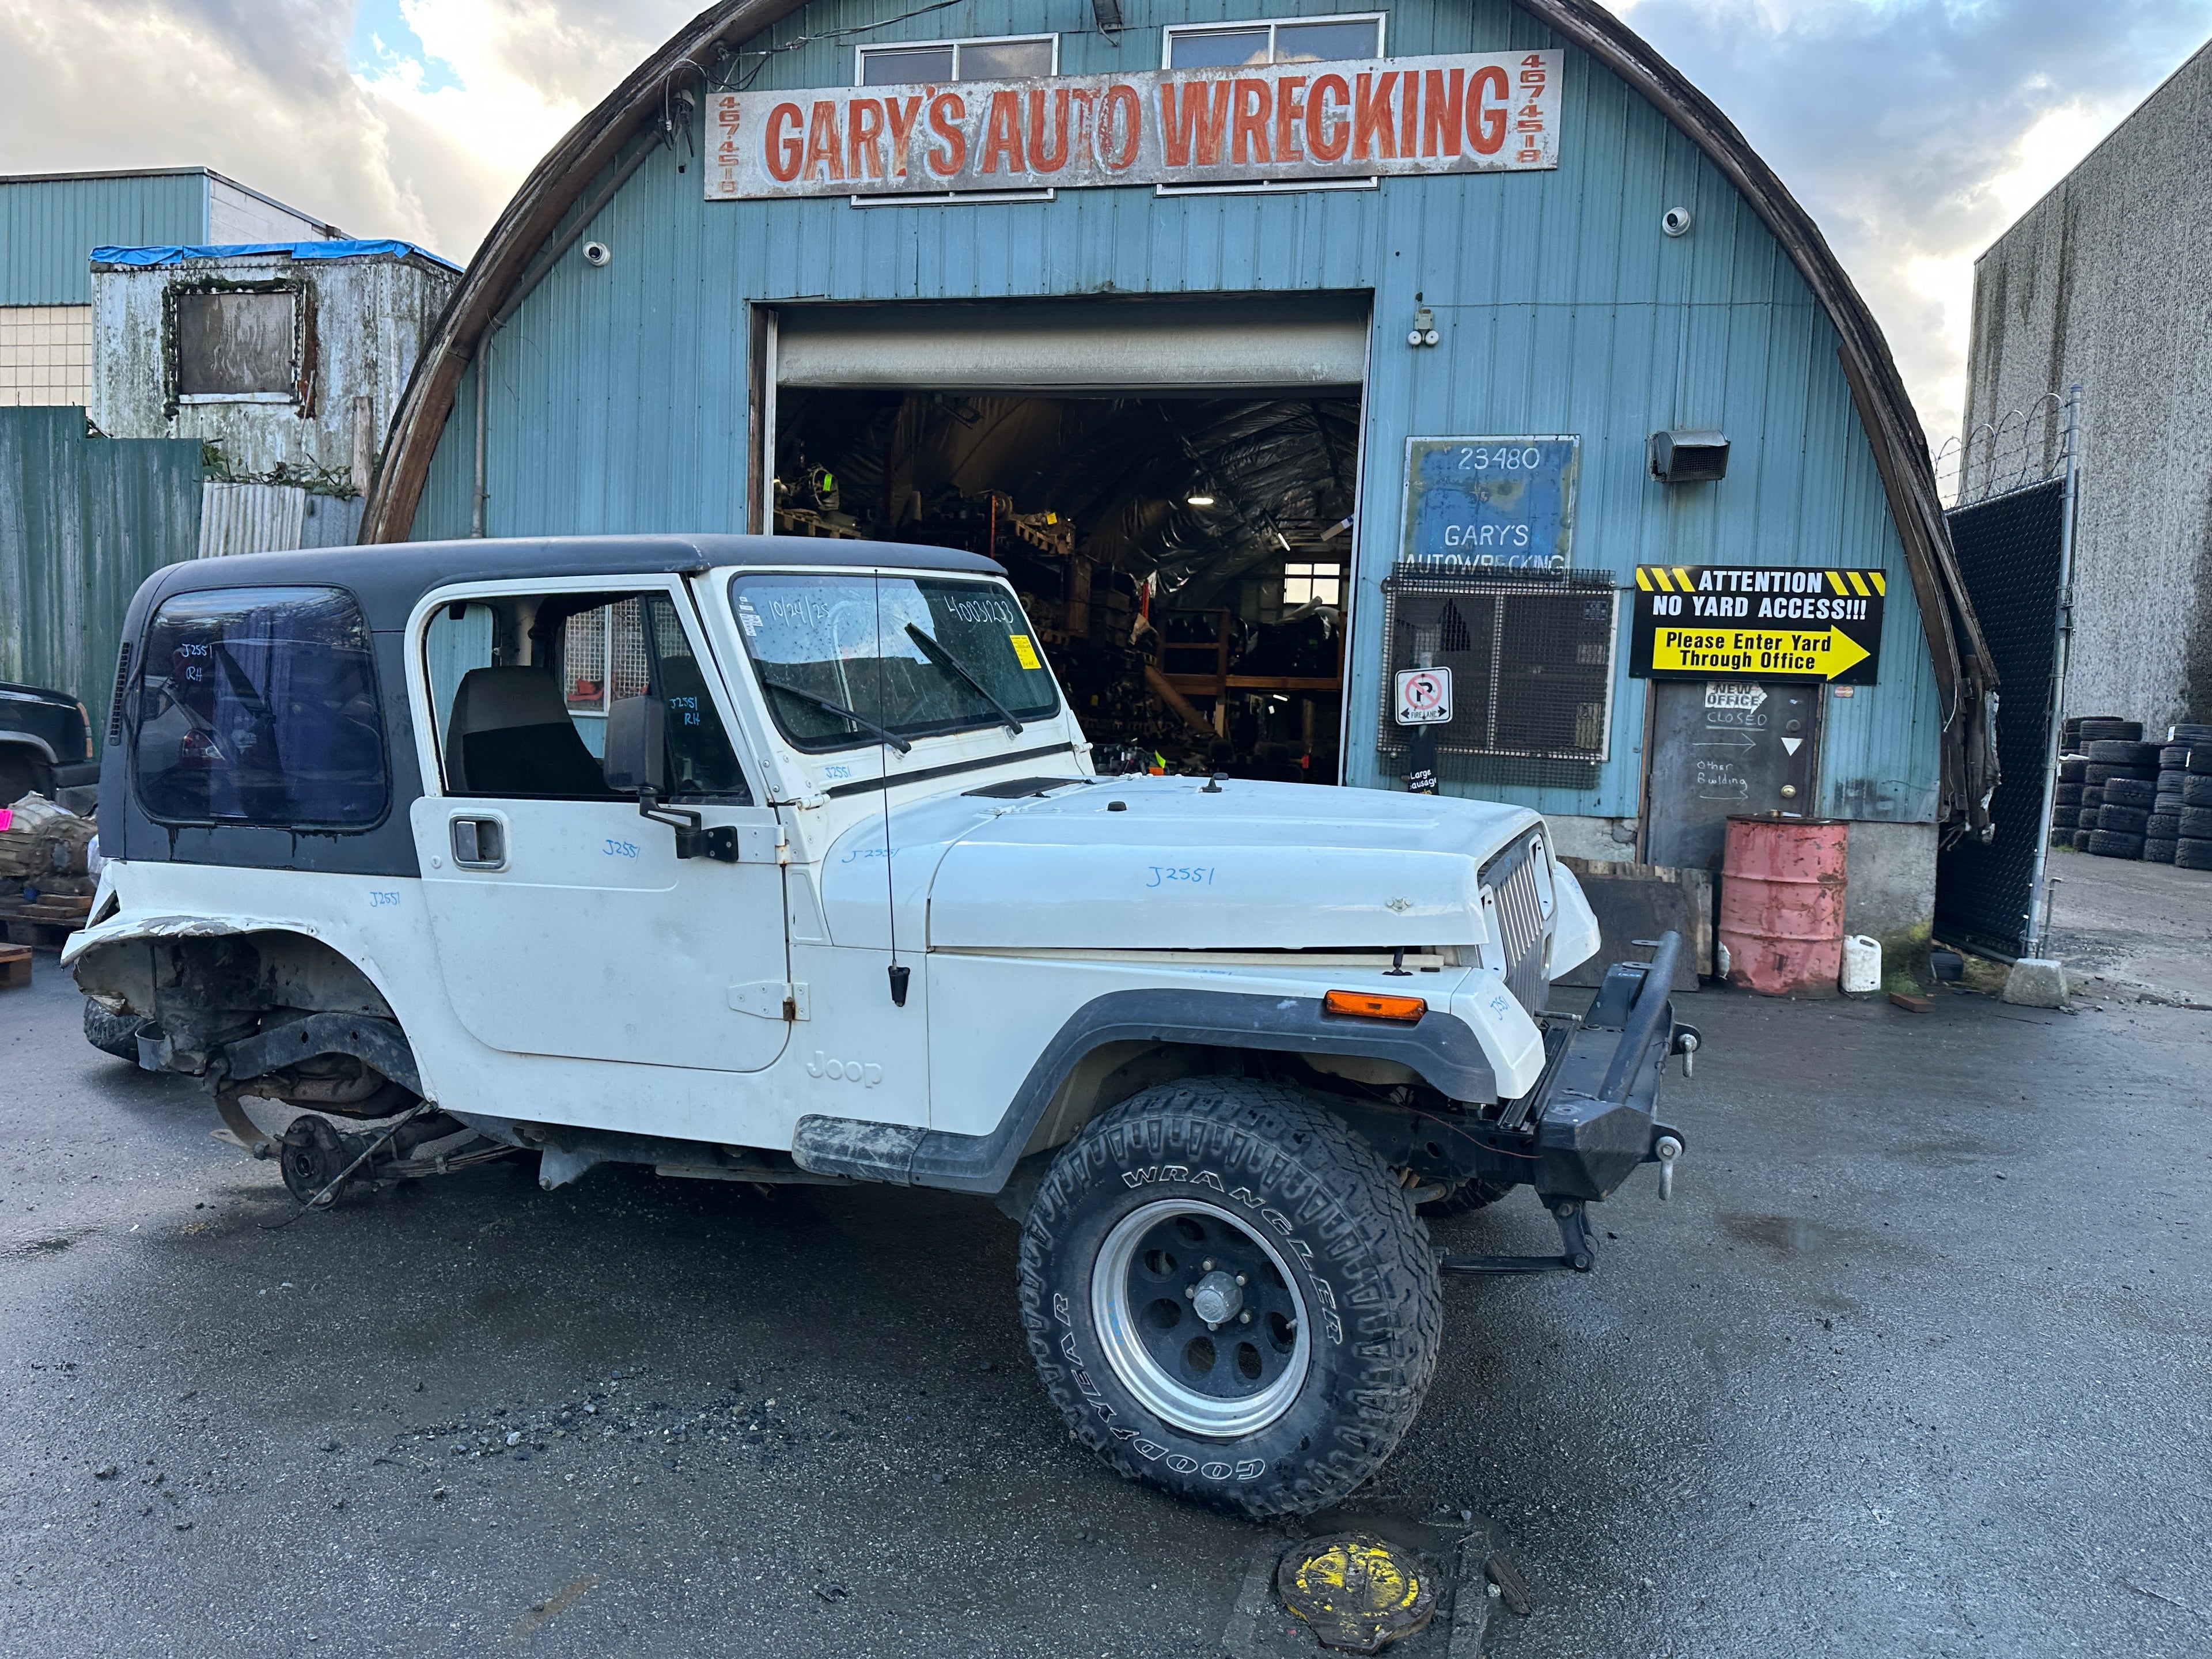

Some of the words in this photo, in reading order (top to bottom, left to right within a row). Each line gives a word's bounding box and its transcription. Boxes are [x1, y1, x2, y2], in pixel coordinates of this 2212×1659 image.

[764, 86, 966, 183] GARY'S
[982, 85, 1141, 174] AUTO
[1161, 66, 1509, 166] WRECKING
[1458, 448, 1540, 469] 23480
[1445, 525, 1529, 546] GARY'S
[1698, 570, 1823, 593] ATTENTION
[1653, 595, 1682, 616] NO
[1693, 596, 1748, 617] YARD
[1758, 598, 1867, 620] ACCESS!!!
[181, 643, 212, 658] J2551
[1666, 632, 1725, 649] Please
[1733, 633, 1783, 650] Enter
[1791, 635, 1831, 652] Yard
[1680, 650, 1752, 670] Through
[1760, 652, 1816, 669] Office
[1707, 693, 1760, 706] OFFICE
[684, 713, 700, 726] RH
[1707, 712, 1767, 726] CLOSED
[825, 766, 852, 778] J2551
[1410, 769, 1431, 779] Large
[1696, 760, 1733, 771] Other
[603, 839, 641, 863] J2551
[1146, 866, 1215, 888] J2551
[369, 892, 400, 907] J2551
[1121, 1165, 1343, 1344] WRANGLER
[1053, 1293, 1266, 1481] GOODYEAR
